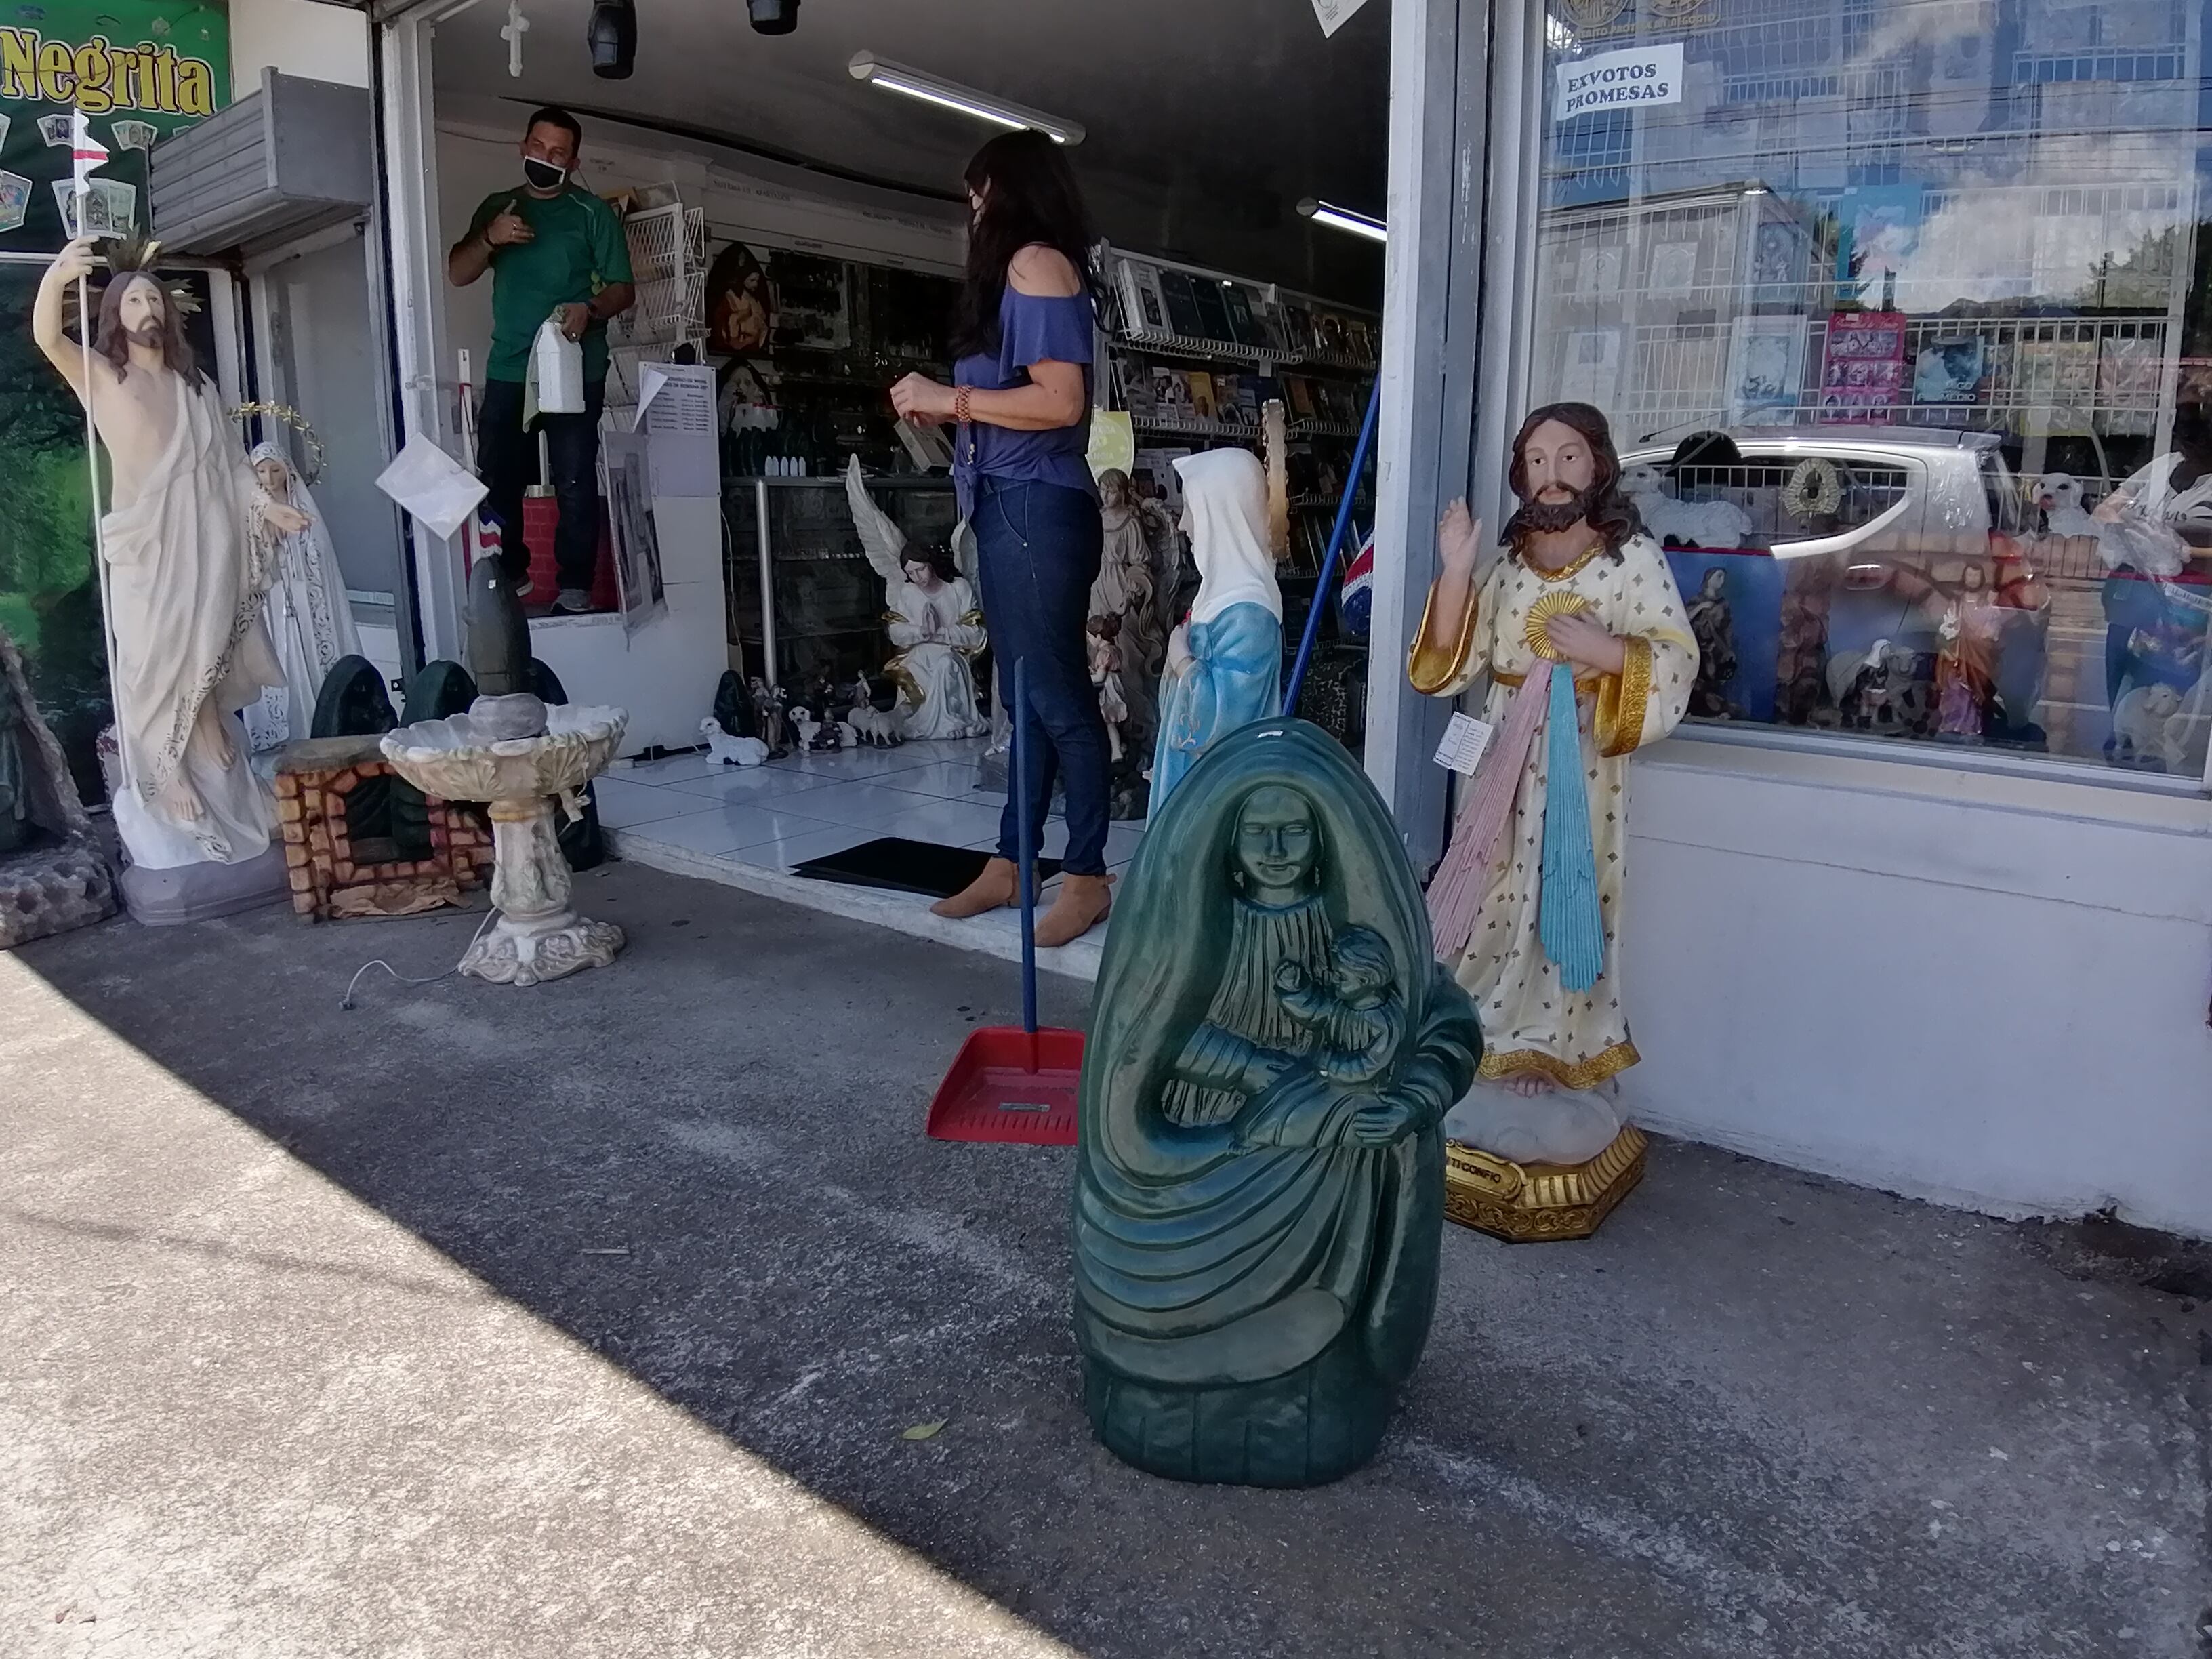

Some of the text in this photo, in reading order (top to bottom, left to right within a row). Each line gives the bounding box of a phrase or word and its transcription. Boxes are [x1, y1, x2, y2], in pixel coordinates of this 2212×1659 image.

[0, 28, 216, 116] Negrita
[1567, 64, 1657, 94] EXVOTOS
[1566, 83, 1670, 112] PROMESAS
[1462, 1162, 1502, 1184] CONFIO
